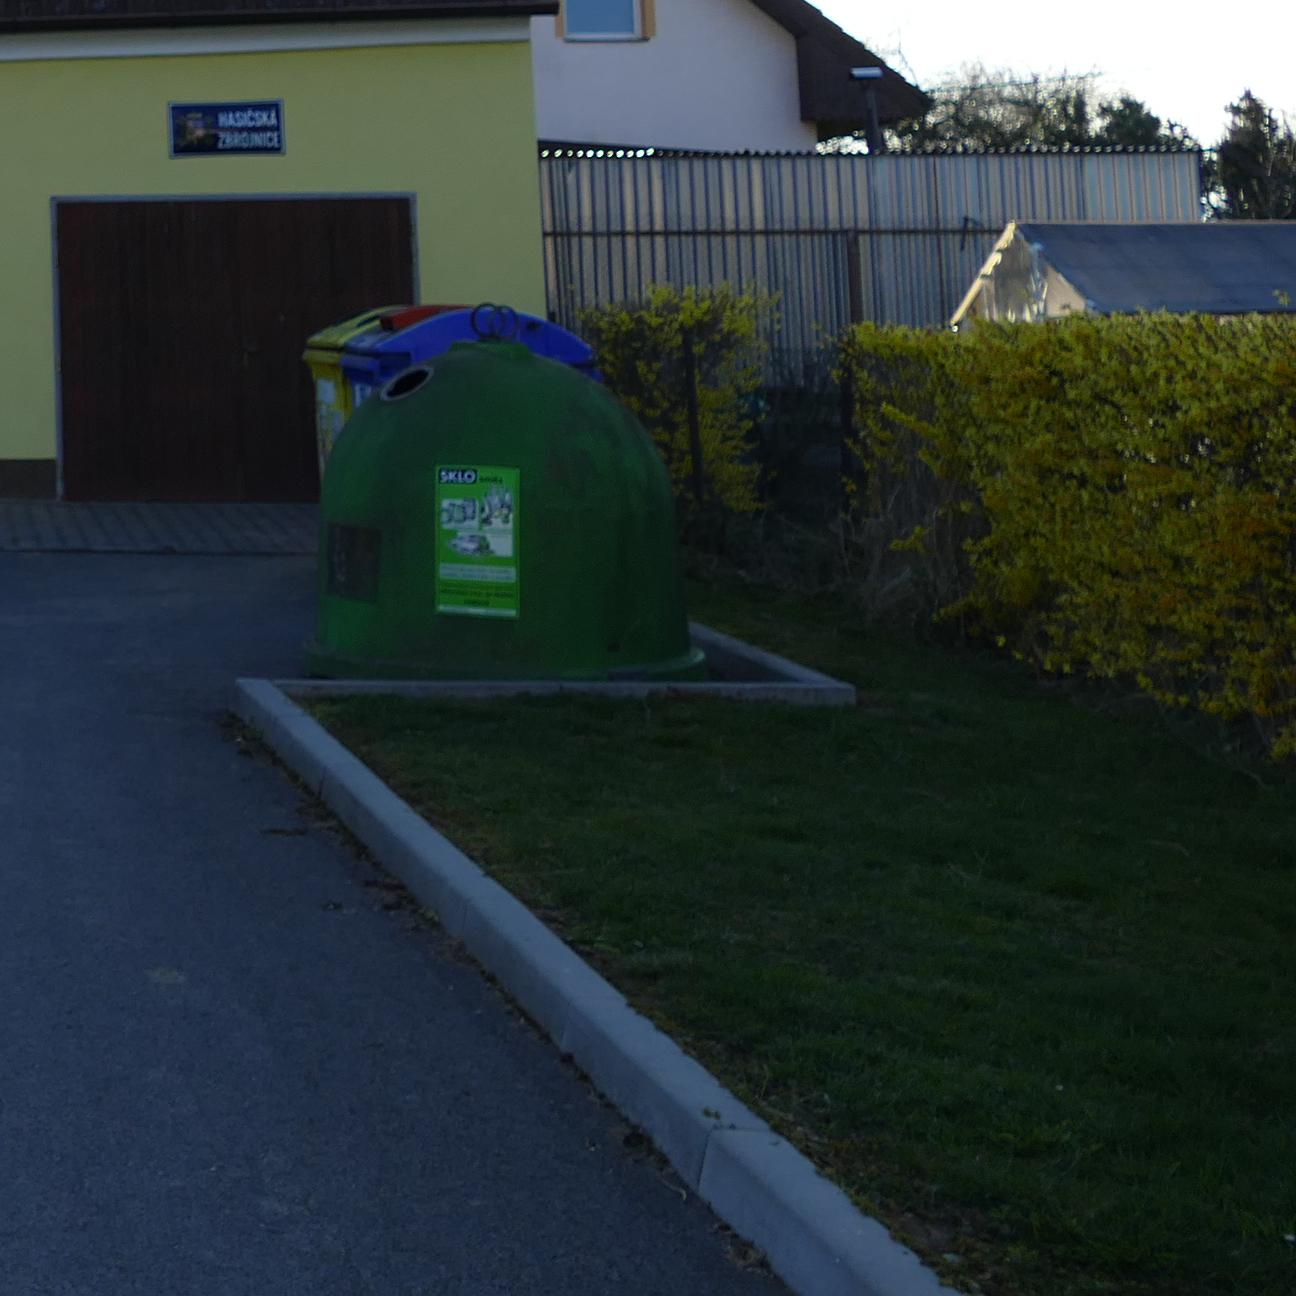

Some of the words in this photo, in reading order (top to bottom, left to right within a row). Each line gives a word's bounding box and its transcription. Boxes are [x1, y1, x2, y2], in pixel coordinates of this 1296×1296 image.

[217, 107, 278, 128] HASIČSKÁ
[217, 131, 281, 149] ZBROJNICE
[440, 469, 476, 483] SKLO
